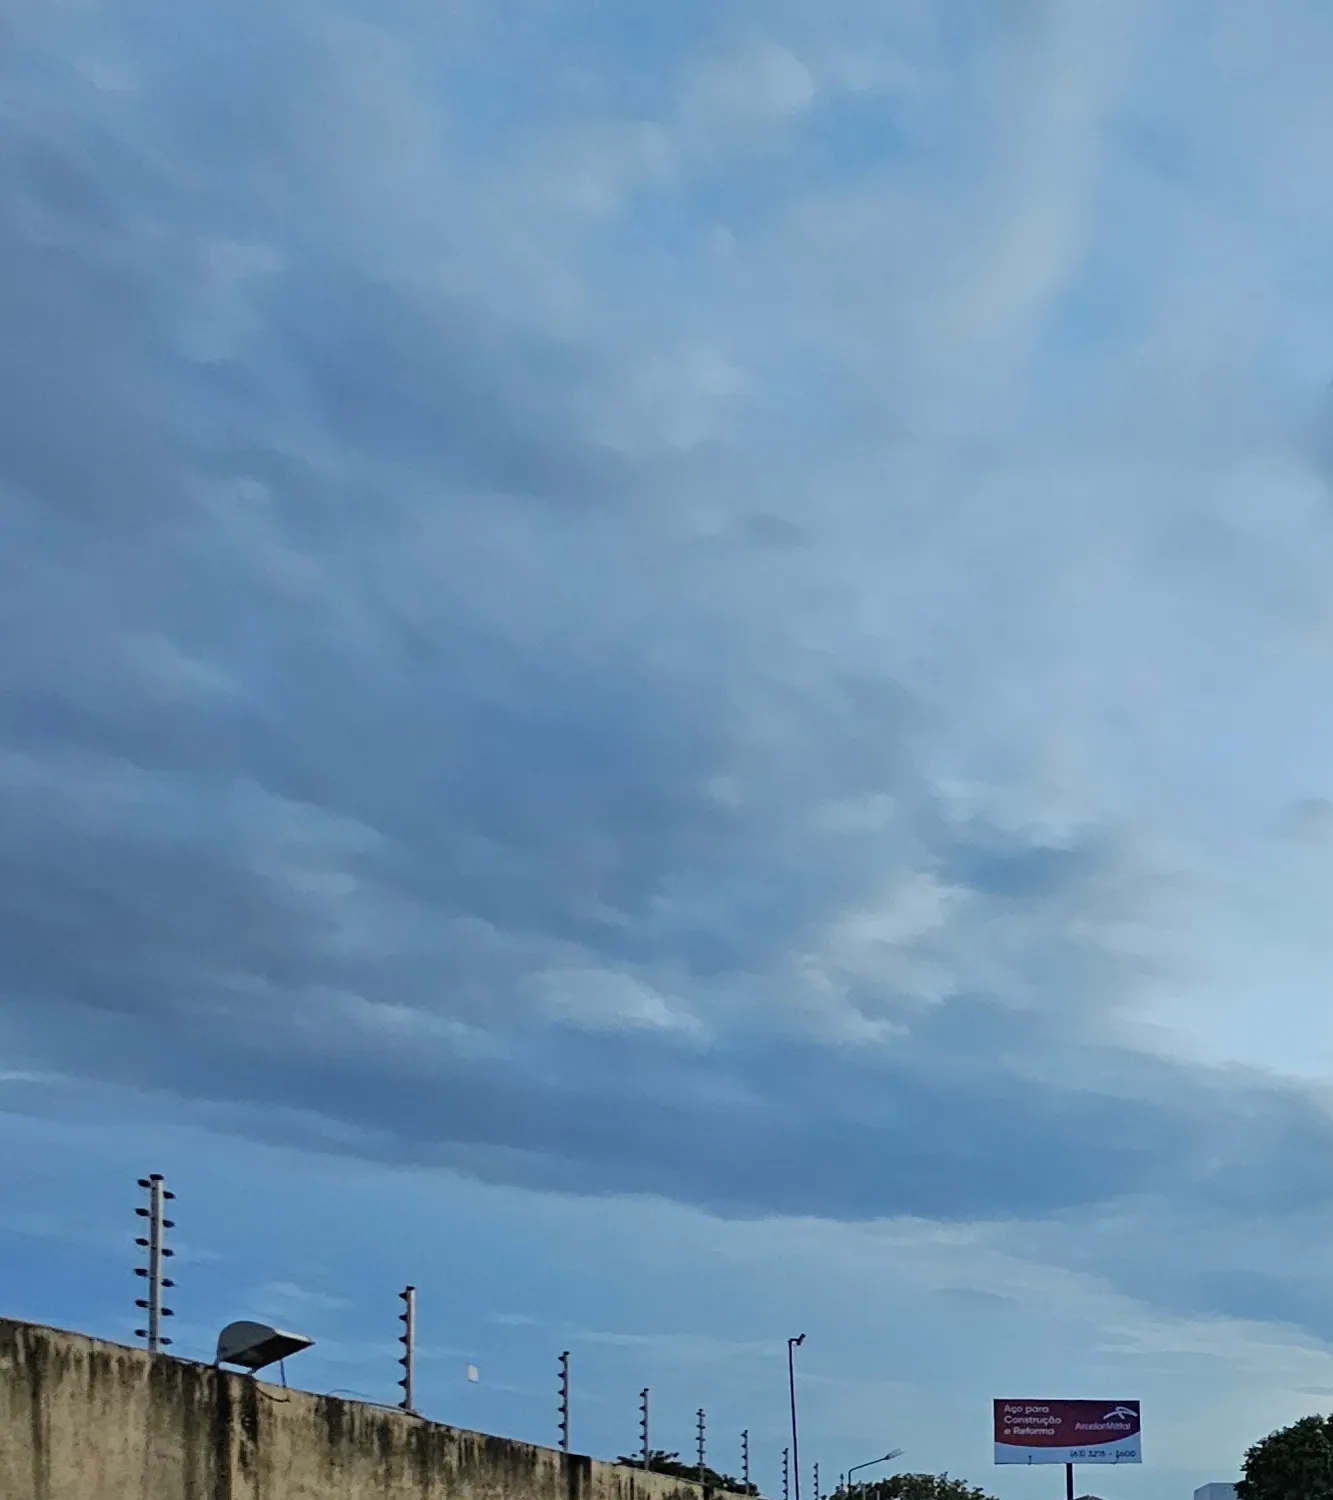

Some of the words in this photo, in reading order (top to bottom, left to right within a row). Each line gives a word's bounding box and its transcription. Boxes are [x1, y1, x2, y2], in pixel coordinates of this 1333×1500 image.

[1004, 1404, 1023, 1415] Aço
[1025, 1406, 1050, 1415] para
[1004, 1415, 1063, 1426] Construção
[1013, 1427, 1055, 1435] Reforma
[1075, 1422, 1131, 1431] ArcelorMittal
